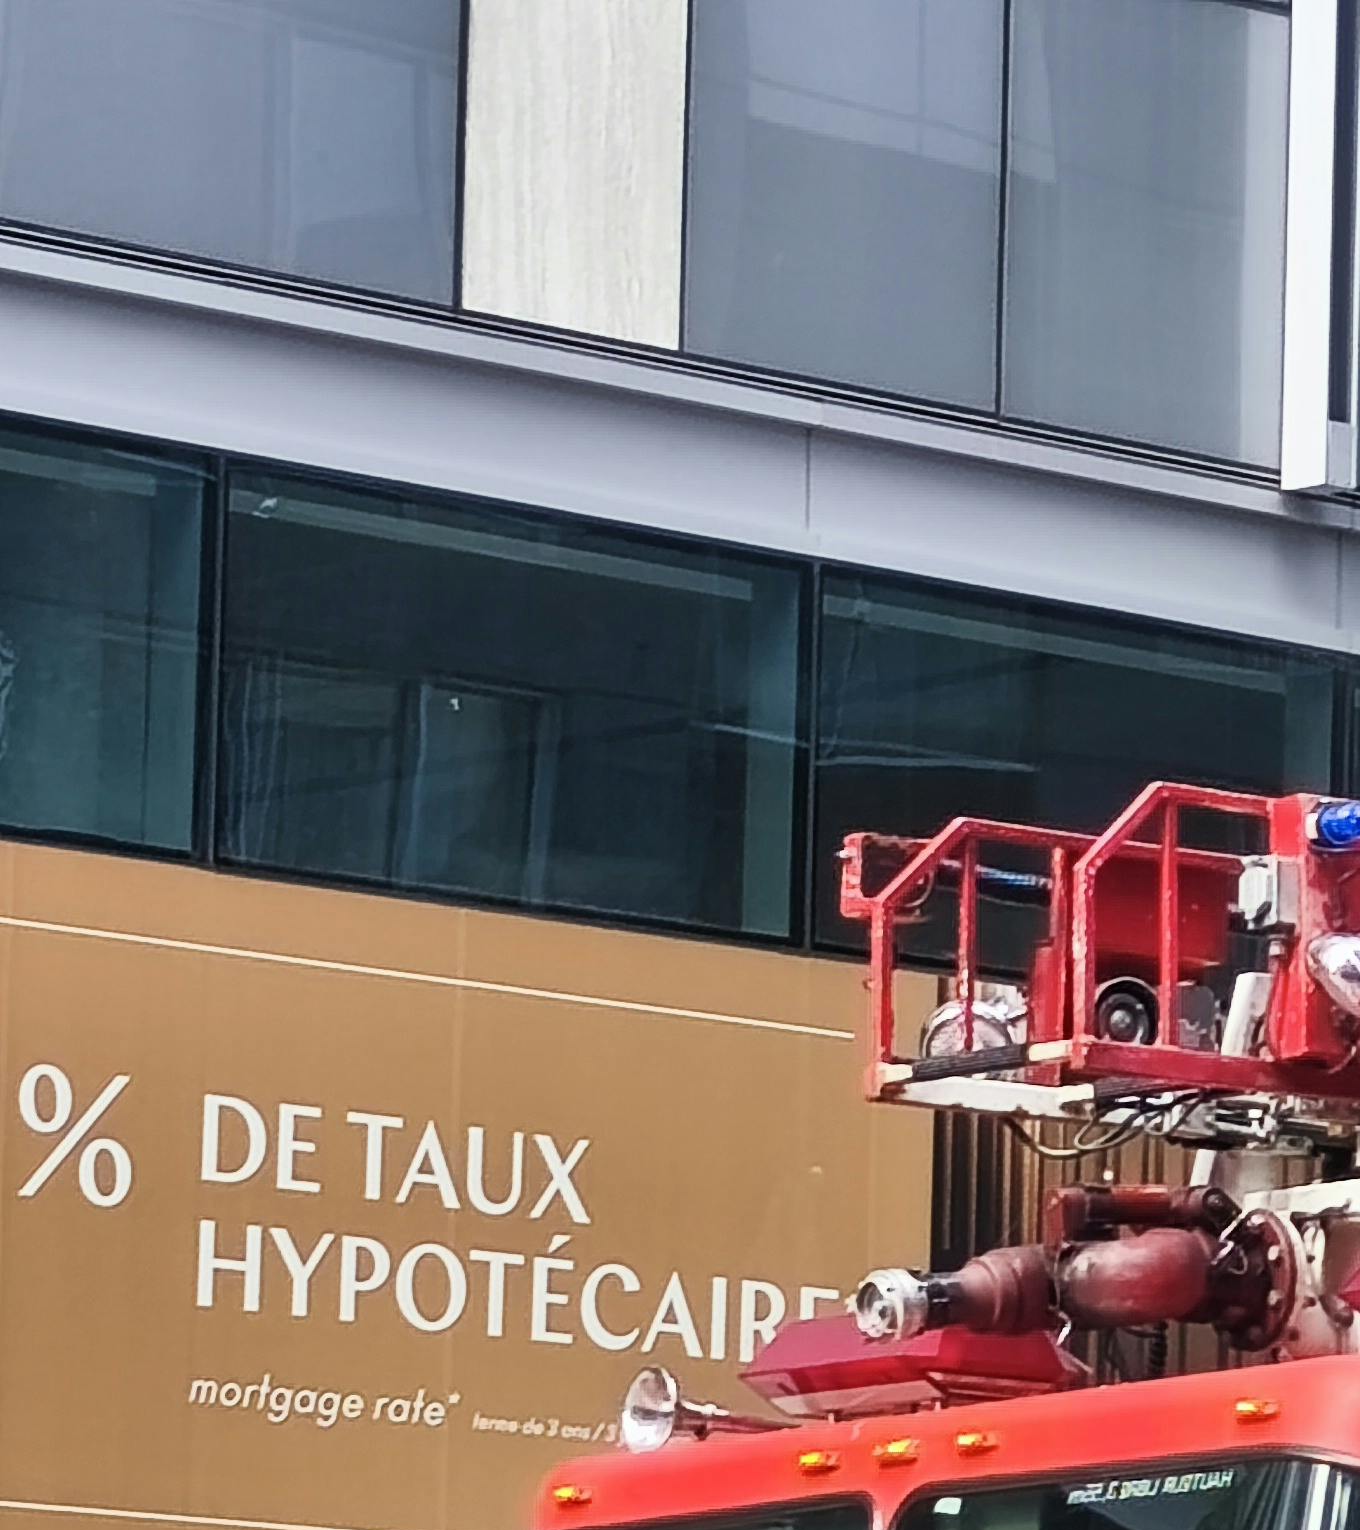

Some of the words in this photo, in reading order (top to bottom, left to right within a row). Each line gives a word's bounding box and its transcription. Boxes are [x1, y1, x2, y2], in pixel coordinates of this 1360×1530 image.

[18, 1063, 132, 1207] %
[201, 1093, 322, 1193] DE
[346, 1110, 591, 1224] TAUX
[189, 1373, 364, 1427] mortgage
